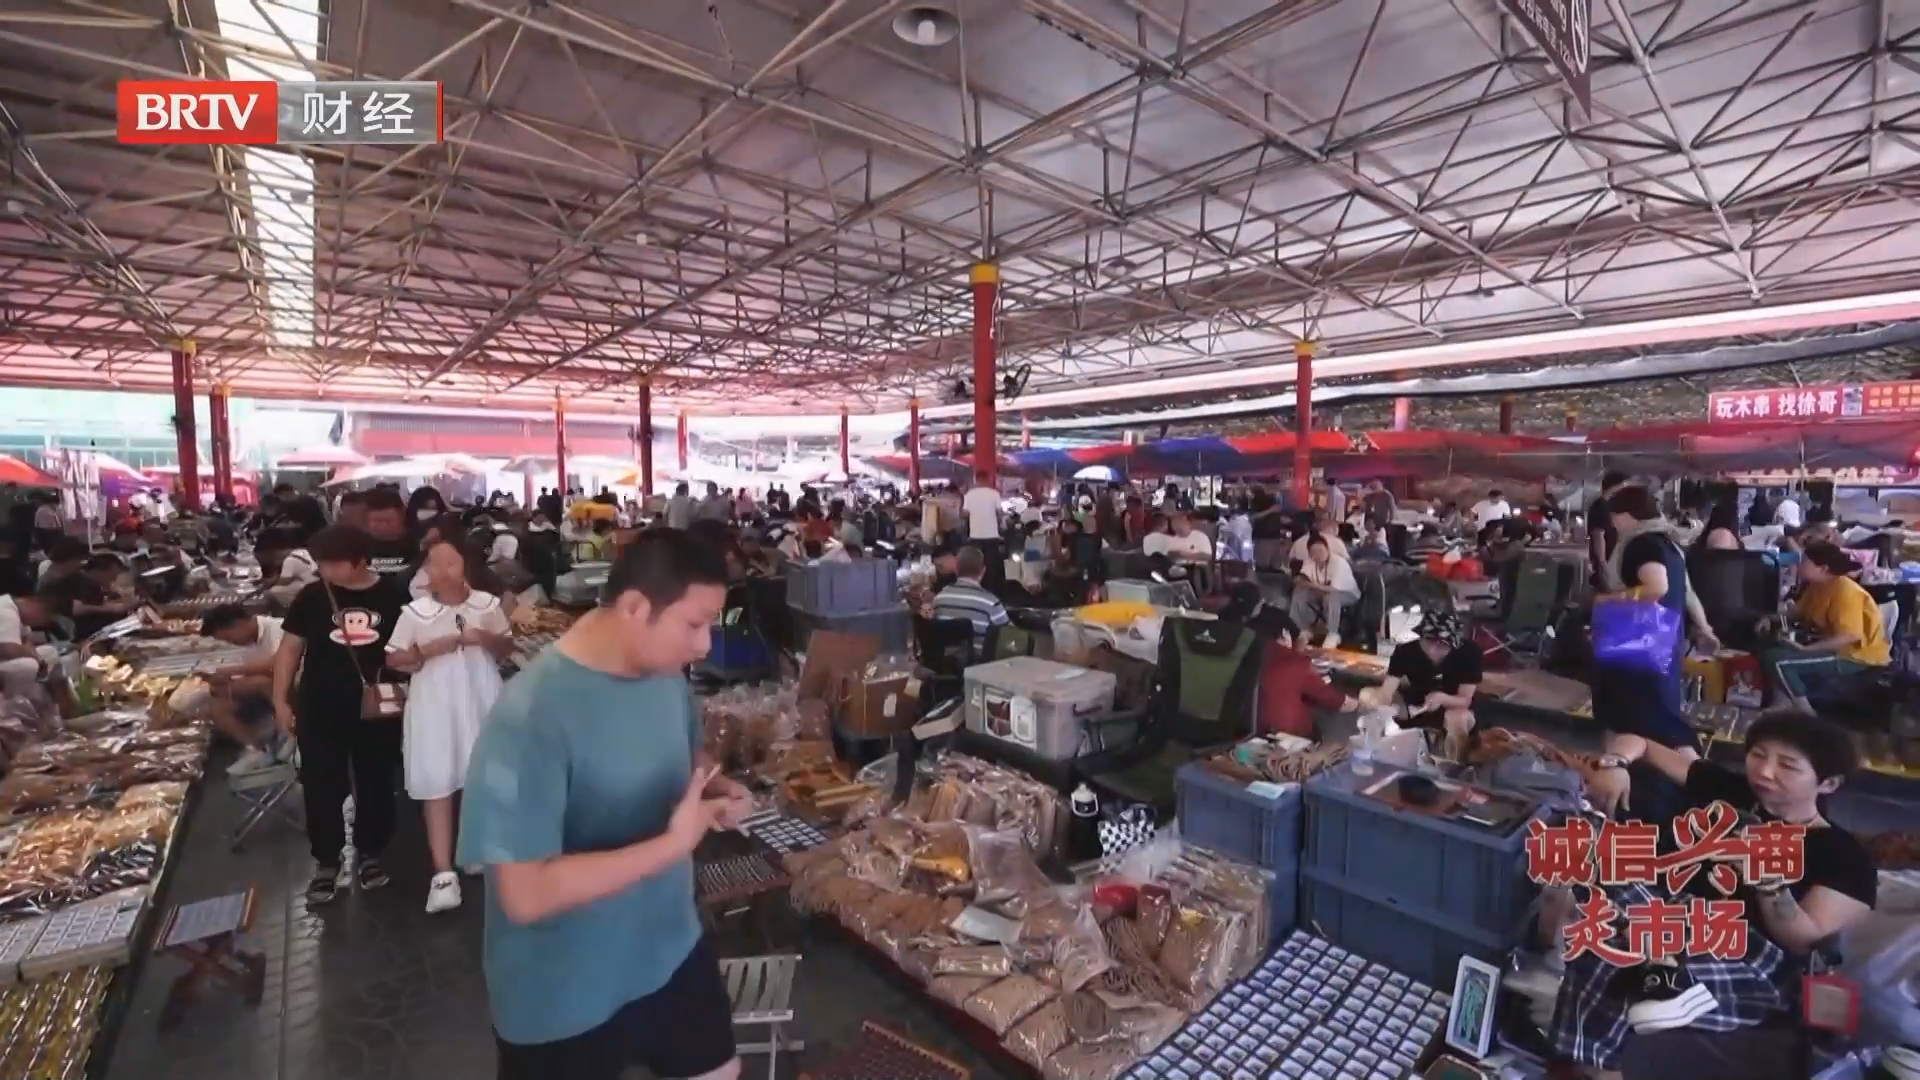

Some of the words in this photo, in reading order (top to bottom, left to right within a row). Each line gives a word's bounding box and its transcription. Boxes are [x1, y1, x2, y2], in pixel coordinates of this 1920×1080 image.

[1715, 394, 1770, 418] 玩木串
[1778, 390, 1837, 416] 找徐哥
